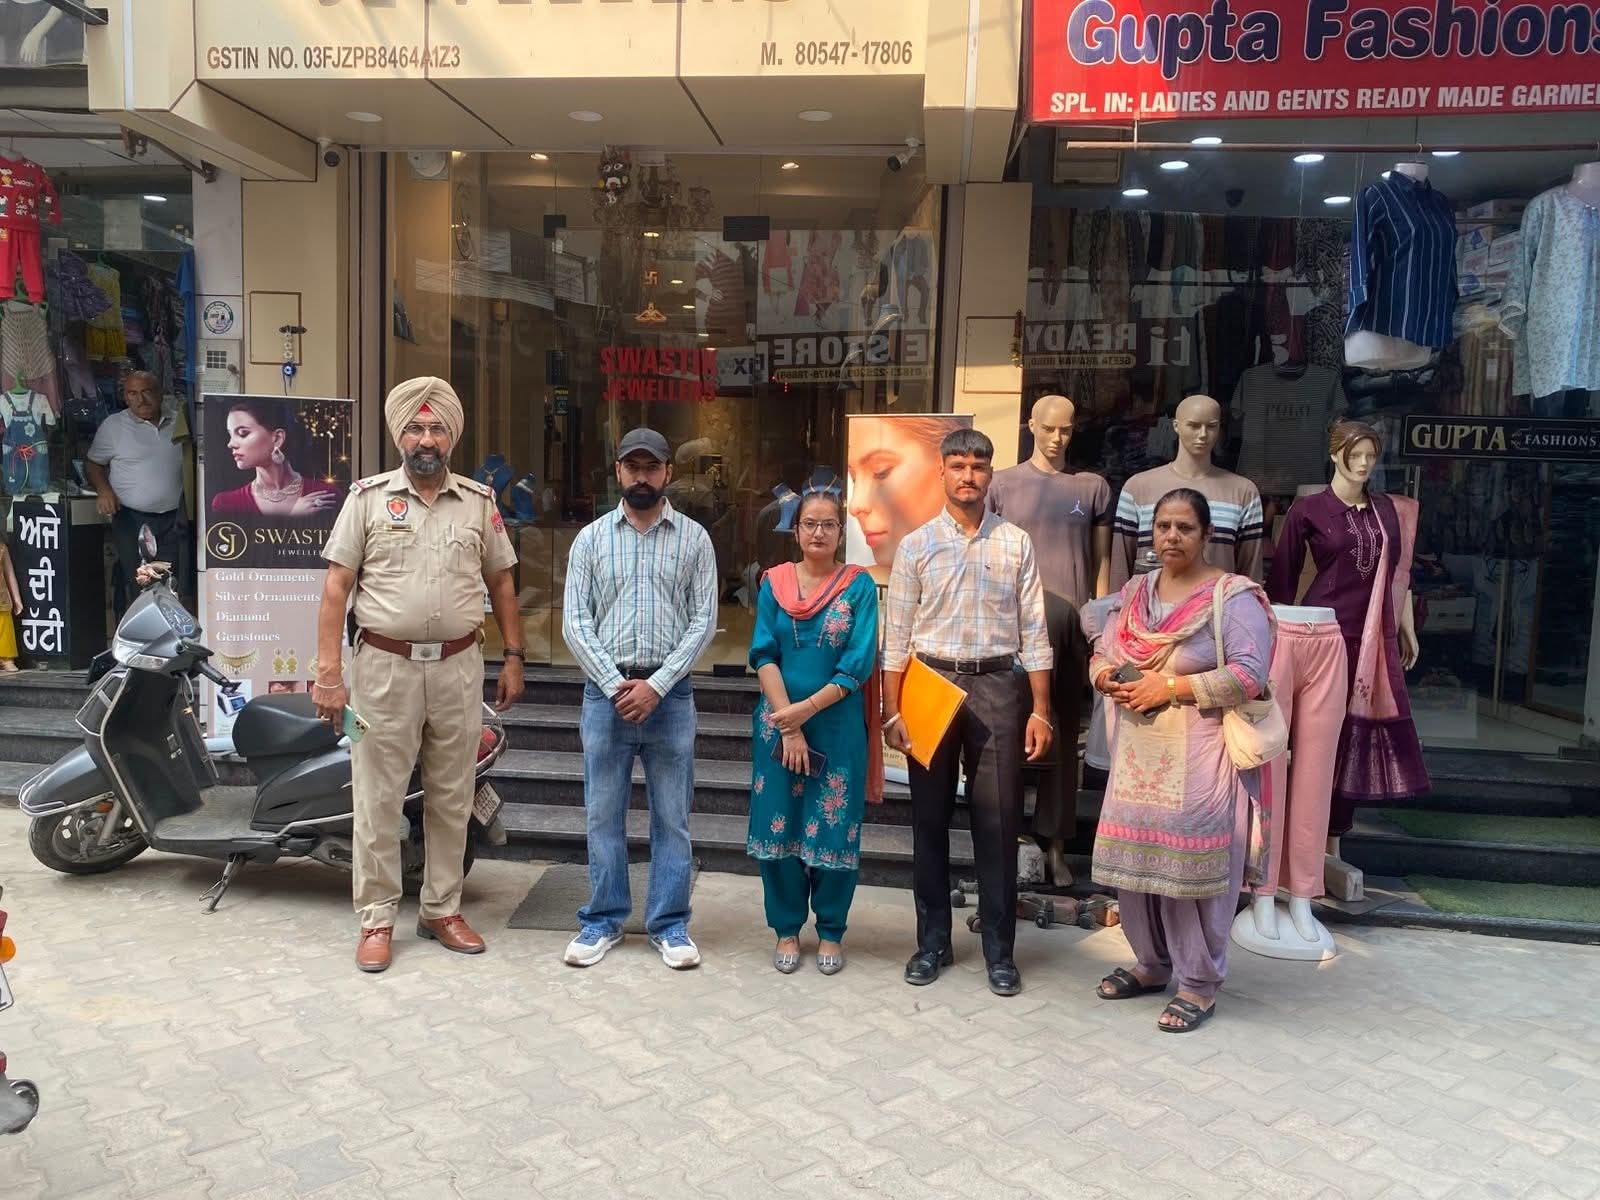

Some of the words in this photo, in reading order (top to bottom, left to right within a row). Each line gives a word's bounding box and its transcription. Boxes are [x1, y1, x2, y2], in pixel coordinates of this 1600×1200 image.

[761, 42, 783, 65] M.
[795, 41, 913, 65] 80547-17806
[1067, 0, 1281, 80] Gupta
[1304, 0, 1600, 61] Fashion
[207, 46, 259, 69] GSTIN
[268, 47, 298, 69] NO.
[1050, 92, 1096, 113] SPL.
[1104, 93, 1133, 113] IN:
[1140, 91, 1216, 112] LADIES
[1223, 91, 1269, 111] AND
[1277, 88, 1349, 111] GENTS
[1356, 87, 1431, 109] READY
[1437, 86, 1504, 108] MADE
[1512, 83, 1600, 106] GARME
[600, 347, 719, 376] SWASTIK
[603, 378, 717, 401] JEWELLERS
[1411, 423, 1507, 451] GUPTA
[1525, 433, 1597, 448] FASHIONS
[19, 504, 61, 549] ਅਜੇ
[28, 556, 55, 602] ਦੀ
[215, 571, 244, 582] Gold
[249, 571, 316, 582] Ornaments
[215, 591, 250, 602] Silver
[254, 591, 321, 602] Ornaments
[216, 611, 270, 622] Diamond
[21, 607, 64, 653] ਹੱਟੀ
[216, 631, 281, 642] Gemstones
